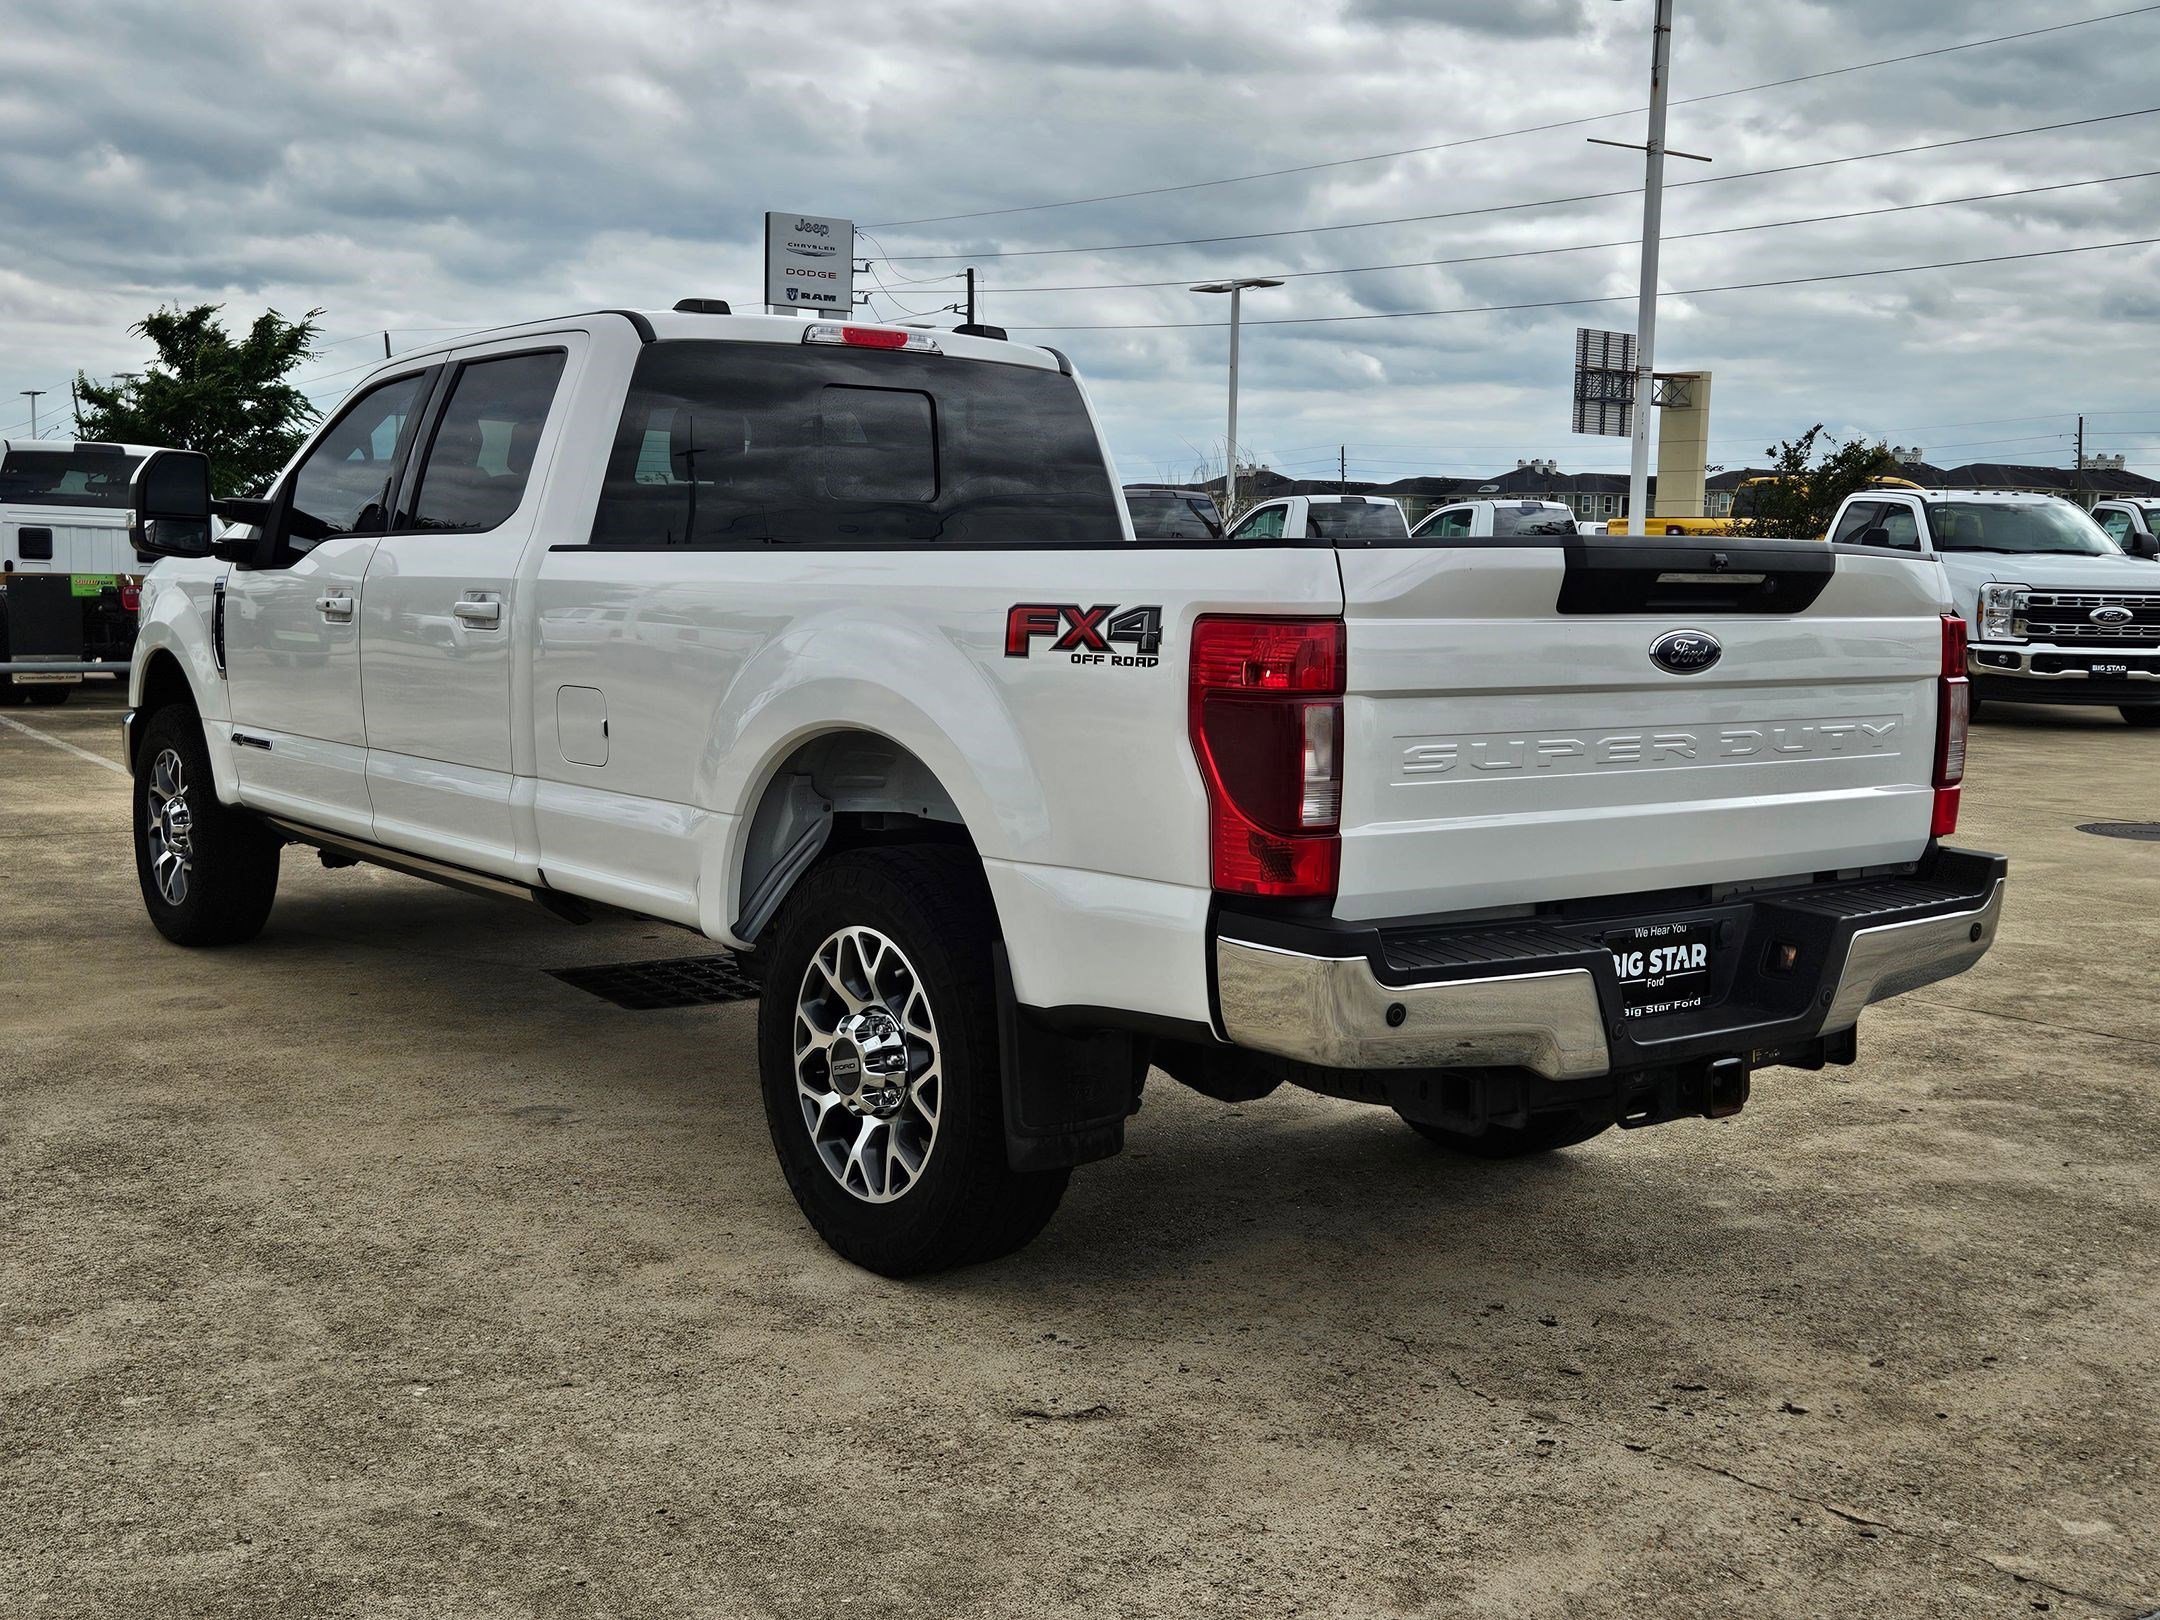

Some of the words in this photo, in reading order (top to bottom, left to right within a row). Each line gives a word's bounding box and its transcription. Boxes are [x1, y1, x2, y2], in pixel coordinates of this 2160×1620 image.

[795, 219, 829, 237] Jeep
[788, 242, 835, 251] CHRYSLER
[786, 268, 836, 279] DODGE
[801, 292, 836, 302] RAM
[1004, 603, 1163, 659] FX4
[1670, 638, 1708, 664] Ford
[1071, 654, 1105, 665] OFF
[1111, 656, 1159, 667] ROAD
[1402, 733, 1697, 774] SUPER
[1719, 721, 1897, 757] DUTY
[1635, 927, 1649, 938] We
[1650, 926, 1670, 937] Hear
[1672, 923, 1687, 933] You
[1649, 943, 1707, 974] STAR
[1647, 976, 1665, 988] Ford
[1645, 1003, 1671, 1014] Star
[1674, 997, 1701, 1010] Ford
